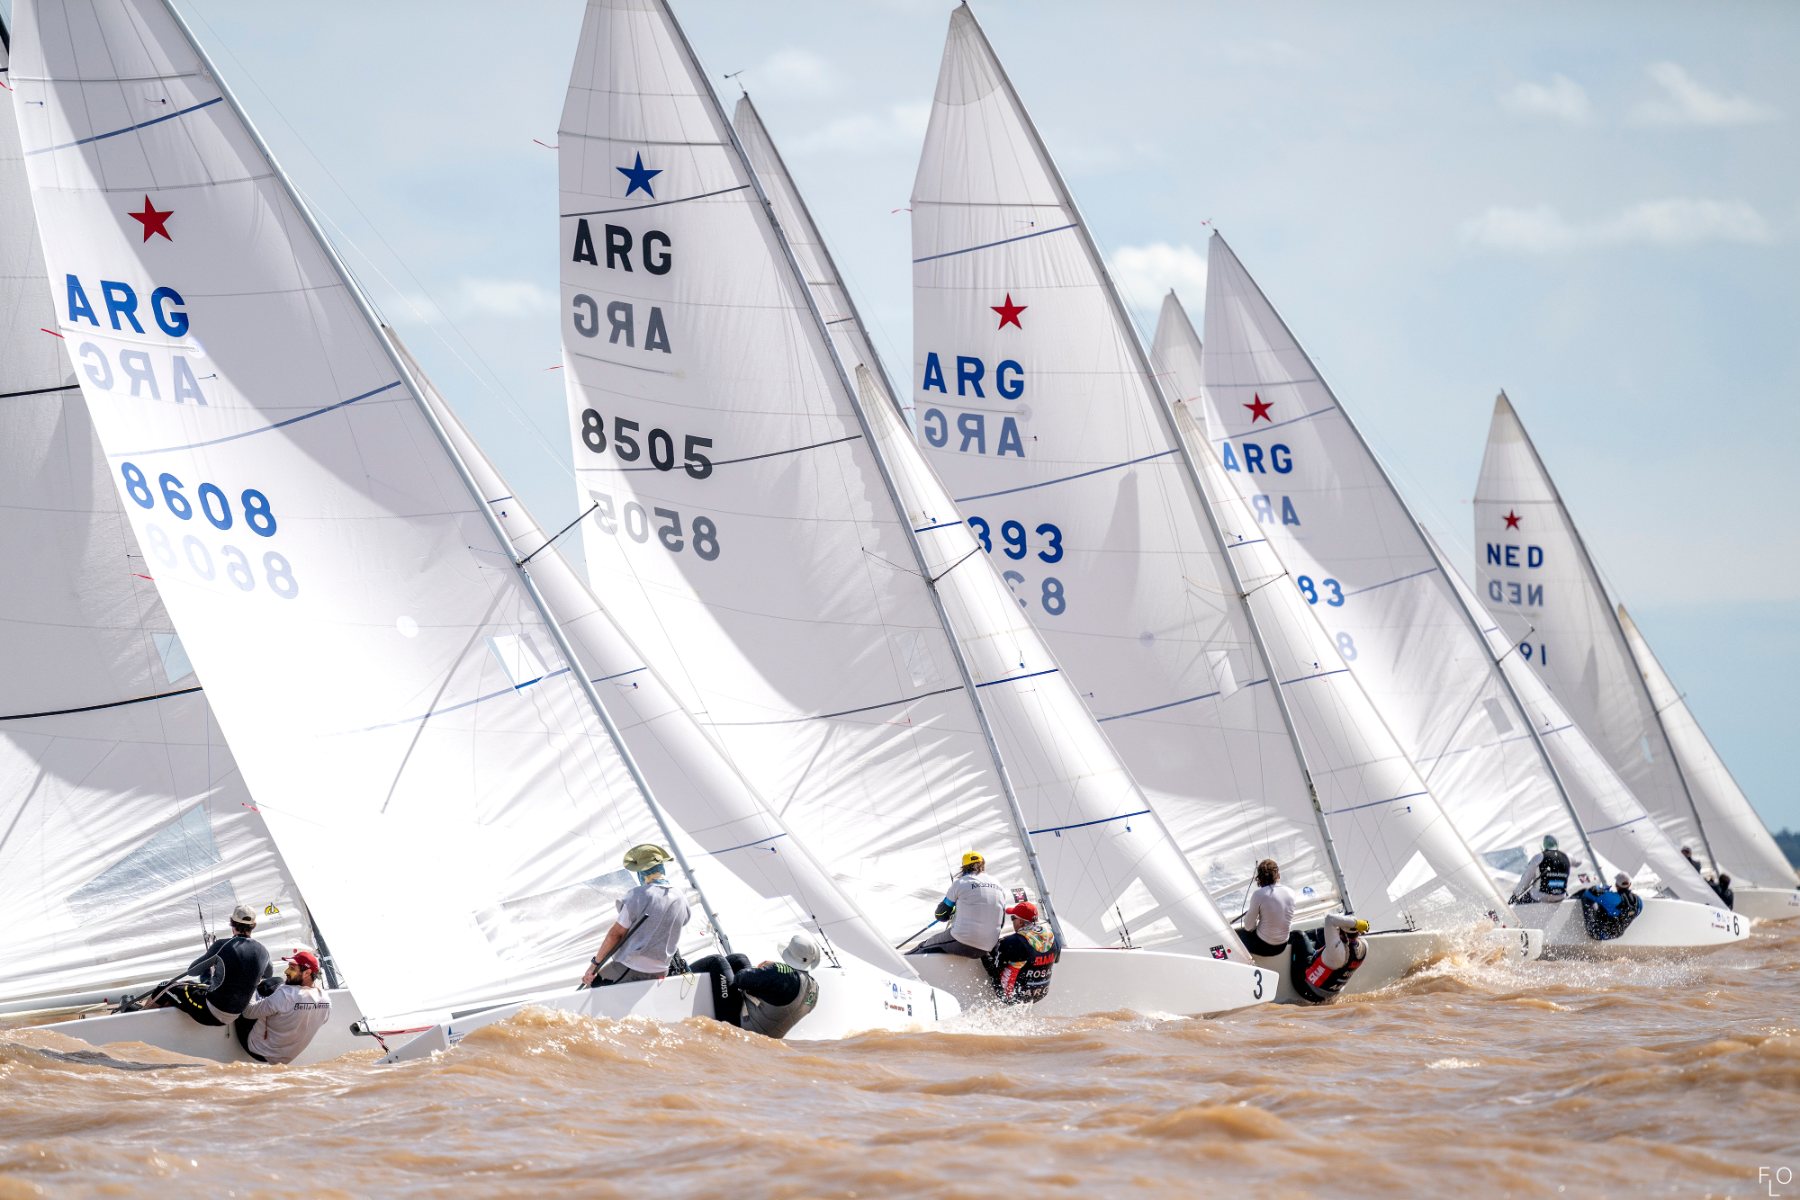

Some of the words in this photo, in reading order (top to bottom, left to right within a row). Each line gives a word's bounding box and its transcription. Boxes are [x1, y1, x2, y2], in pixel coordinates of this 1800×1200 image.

[572, 218, 672, 276] ARG
[65, 273, 190, 338] ARG
[923, 352, 1024, 400] ARG
[581, 408, 713, 480] 8505
[1223, 442, 1293, 474] ARG
[120, 461, 277, 538] 8608
[967, 516, 1064, 564] 393
[1487, 543, 1544, 569] NED
[1297, 575, 1345, 607] 83
[1520, 642, 1546, 667] 91
[1733, 915, 1740, 936] 6
[720, 973, 729, 999] MUSTO
[1253, 969, 1263, 1000] 3
[930, 988, 938, 1021] 1
